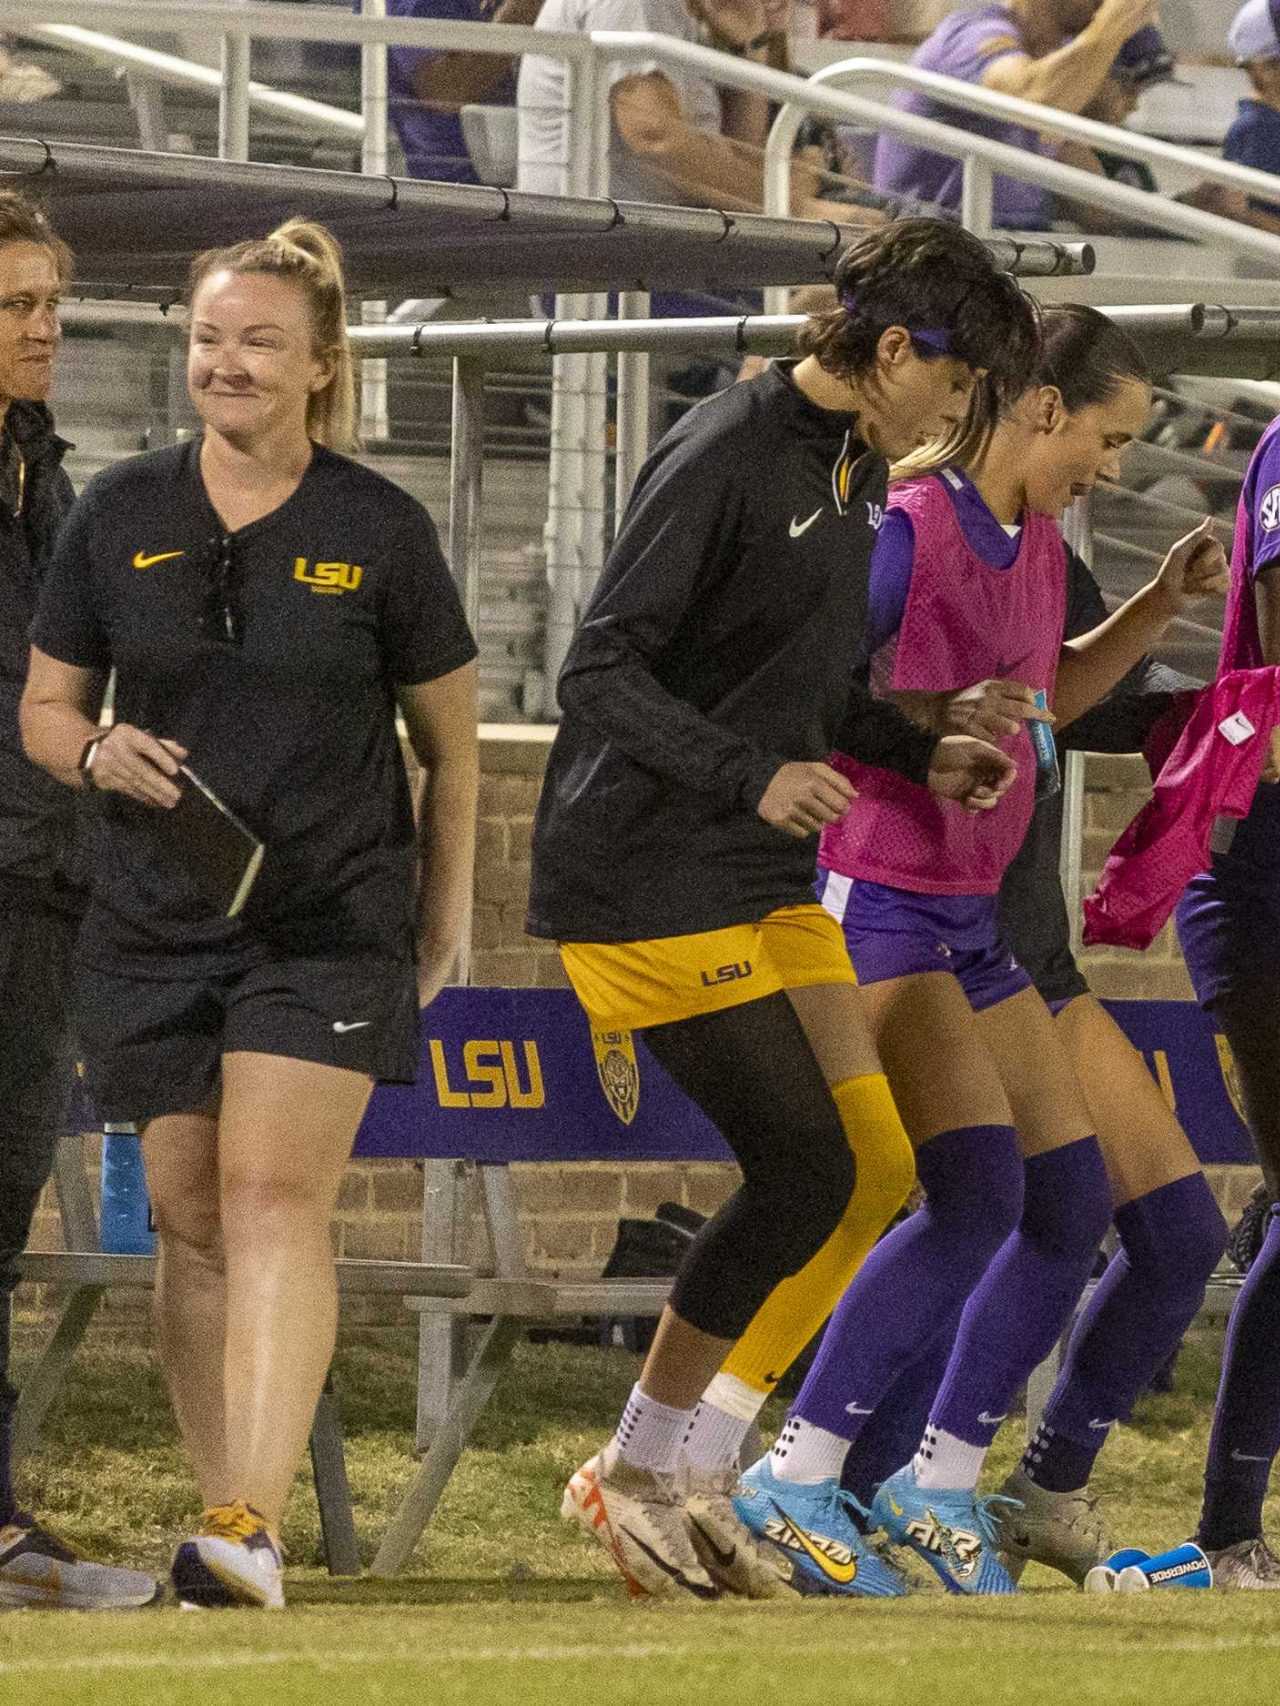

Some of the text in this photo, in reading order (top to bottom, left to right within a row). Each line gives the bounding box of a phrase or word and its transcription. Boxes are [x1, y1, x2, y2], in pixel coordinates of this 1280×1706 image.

[294, 557, 363, 589] LSU
[701, 960, 752, 987] LSU
[429, 1040, 545, 1108] LSU
[1149, 1559, 1207, 1584] POWERADE
